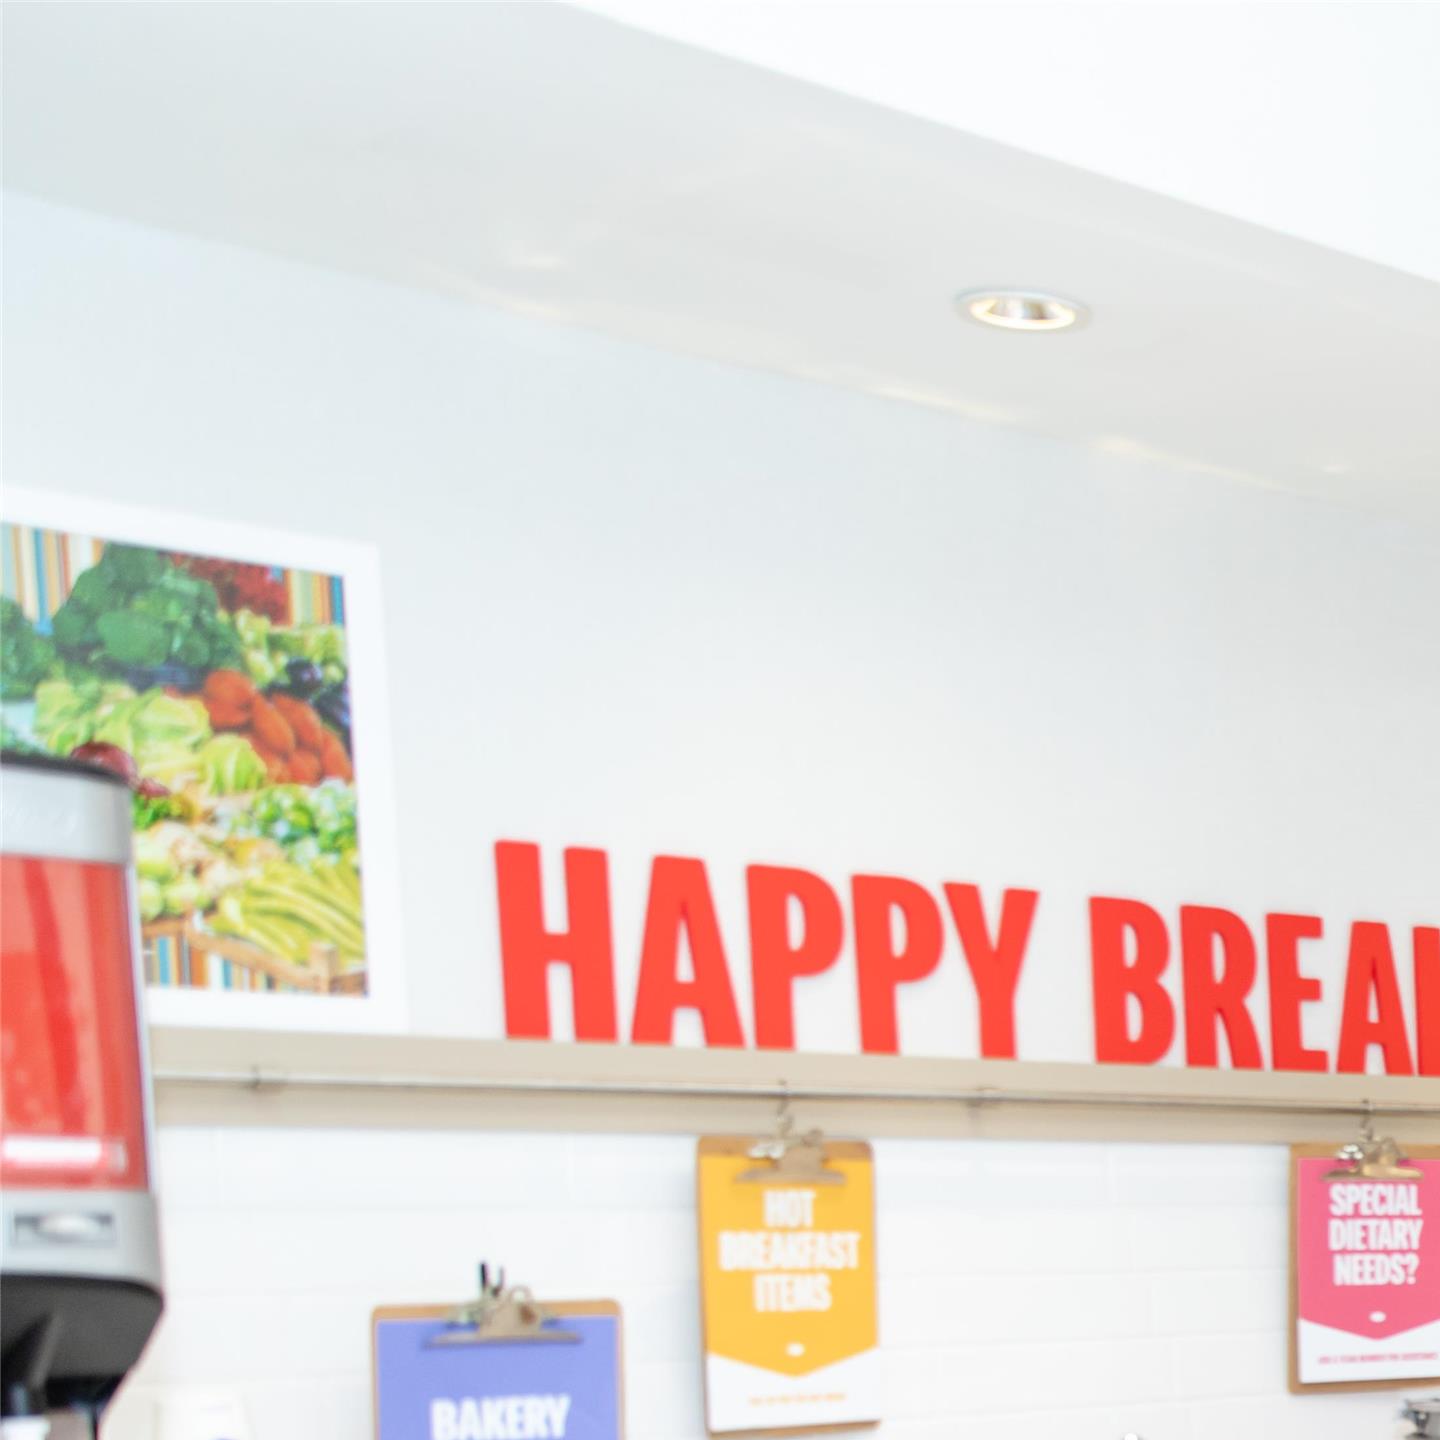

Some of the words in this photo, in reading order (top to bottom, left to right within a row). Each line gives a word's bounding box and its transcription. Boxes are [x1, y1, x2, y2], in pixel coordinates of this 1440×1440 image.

[494, 840, 1039, 1061] HAPPY
[763, 1188, 816, 1228] HOT
[1329, 1183, 1423, 1216] SPECIAL
[717, 1231, 861, 1271] BREAKFAST
[1328, 1218, 1424, 1251] DIETARY
[1333, 1253, 1420, 1286] NEEDS?
[753, 1273, 832, 1313] ITEMS
